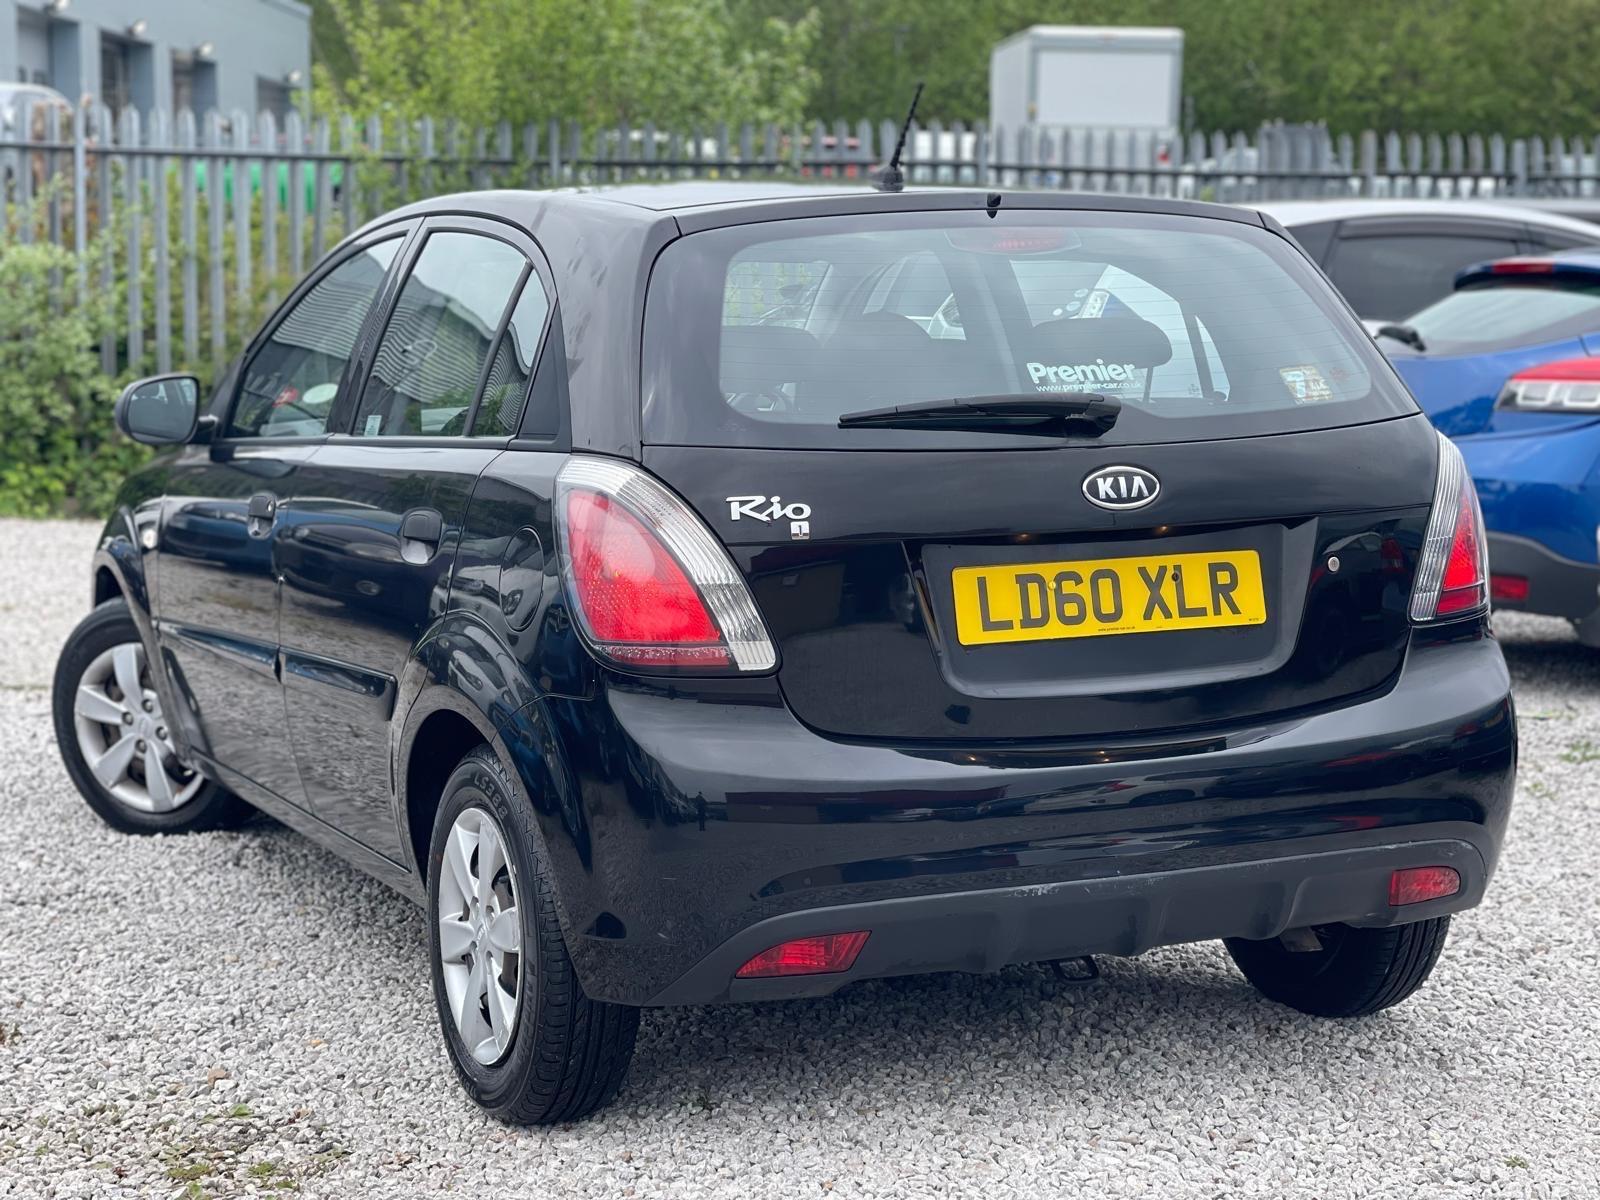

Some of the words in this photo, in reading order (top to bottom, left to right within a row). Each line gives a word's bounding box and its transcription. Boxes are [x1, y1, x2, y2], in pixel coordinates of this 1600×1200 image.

[1026, 358, 1135, 384] Premier
[1096, 475, 1149, 499] KIA
[726, 495, 811, 523] Rio
[976, 568, 1123, 632] LD60
[1137, 561, 1242, 621] XLR
